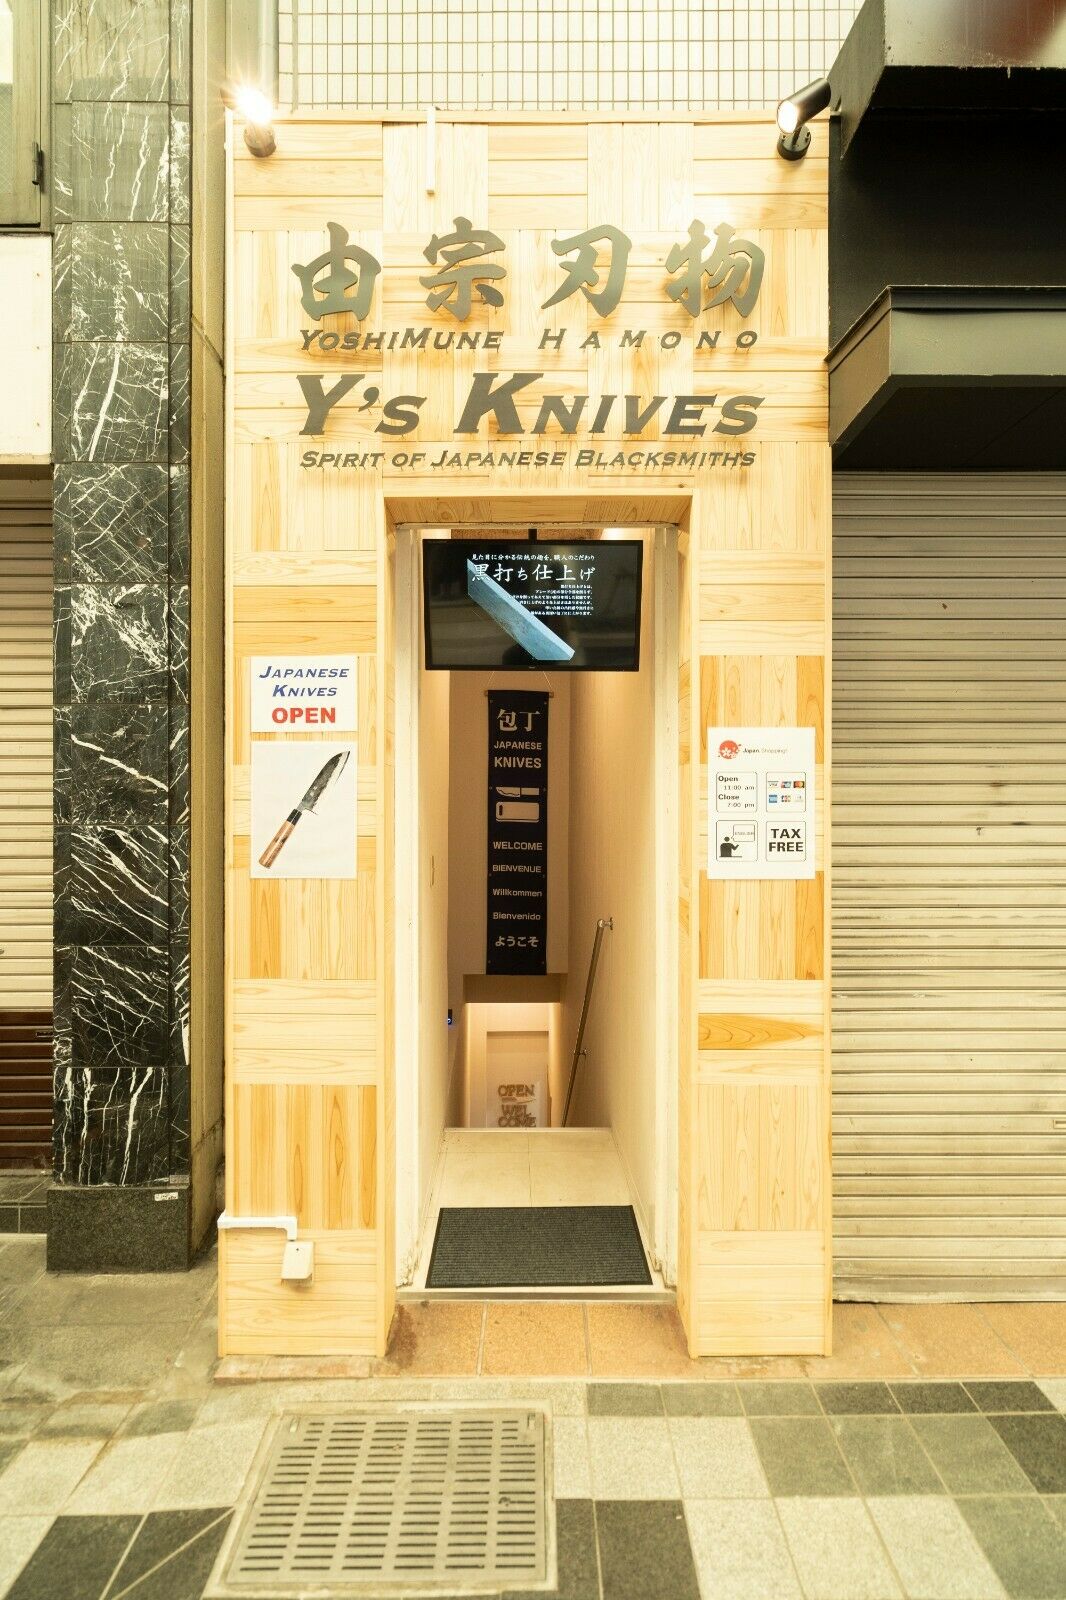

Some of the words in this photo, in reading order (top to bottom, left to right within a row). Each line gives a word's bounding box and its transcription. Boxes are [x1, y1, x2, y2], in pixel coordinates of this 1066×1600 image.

[291, 216, 766, 321] 由宗刃物
[471, 563, 596, 582] 黒打ち仕上げ
[271, 707, 336, 724] OPEN
[496, 708, 541, 732] 包丁
[493, 741, 543, 751] JAPANESE
[493, 756, 543, 769] KNIVES
[770, 828, 801, 839] TAX
[493, 841, 543, 851] WELCOME
[768, 841, 804, 852] FREE
[492, 864, 542, 873] BIENVENUE
[492, 888, 543, 897] Willkommen
[492, 912, 541, 921] Bienvenido
[495, 935, 539, 947] ようこそ
[497, 1084, 536, 1097] OPEN
